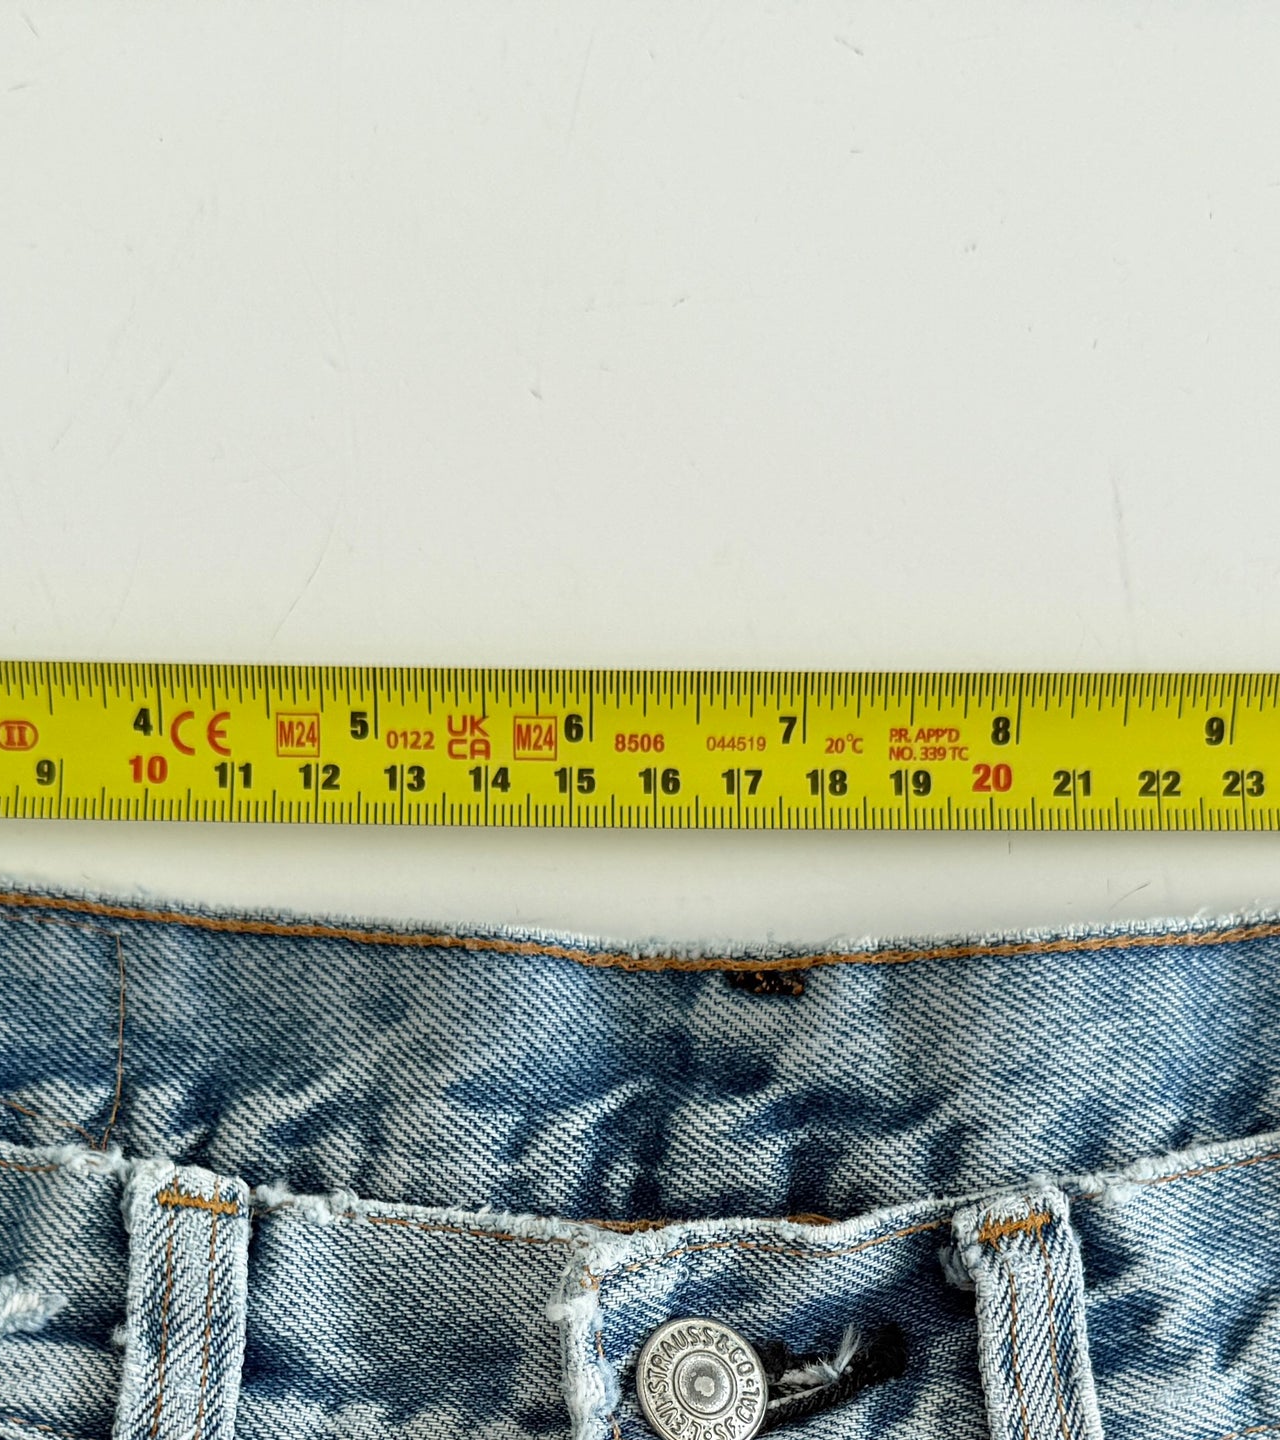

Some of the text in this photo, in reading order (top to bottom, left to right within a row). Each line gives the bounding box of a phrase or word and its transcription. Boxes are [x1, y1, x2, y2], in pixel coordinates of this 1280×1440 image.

[133, 707, 153, 736] 4
[350, 711, 368, 740] 5
[564, 714, 584, 743] 6
[779, 716, 797, 744] 7
[991, 716, 1010, 746] 8
[1205, 717, 1224, 746] 9
[170, 710, 232, 757] CE
[279, 721, 317, 748] M24
[447, 715, 490, 737] UK
[516, 724, 554, 751] M24
[386, 731, 435, 750] 0122
[447, 739, 491, 760] CA
[614, 734, 665, 752] 8506
[706, 736, 767, 752] 044519
[889, 746, 969, 761] NO. 339 TC
[36, 759, 56, 786] 9
[129, 755, 168, 784] 10
[214, 762, 252, 789] 11
[299, 763, 341, 790] 12
[384, 765, 425, 792] 13
[469, 766, 510, 793] 14
[554, 767, 595, 794] 15
[638, 768, 680, 795] 16
[722, 768, 763, 795] 17
[806, 769, 847, 796] 18
[890, 769, 931, 796] 19
[972, 763, 1012, 792] 20
[1053, 770, 1091, 796] 21
[1138, 770, 1181, 797] 22
[1222, 770, 1265, 797] 23
[648, 1326, 714, 1394] STRAUSS
